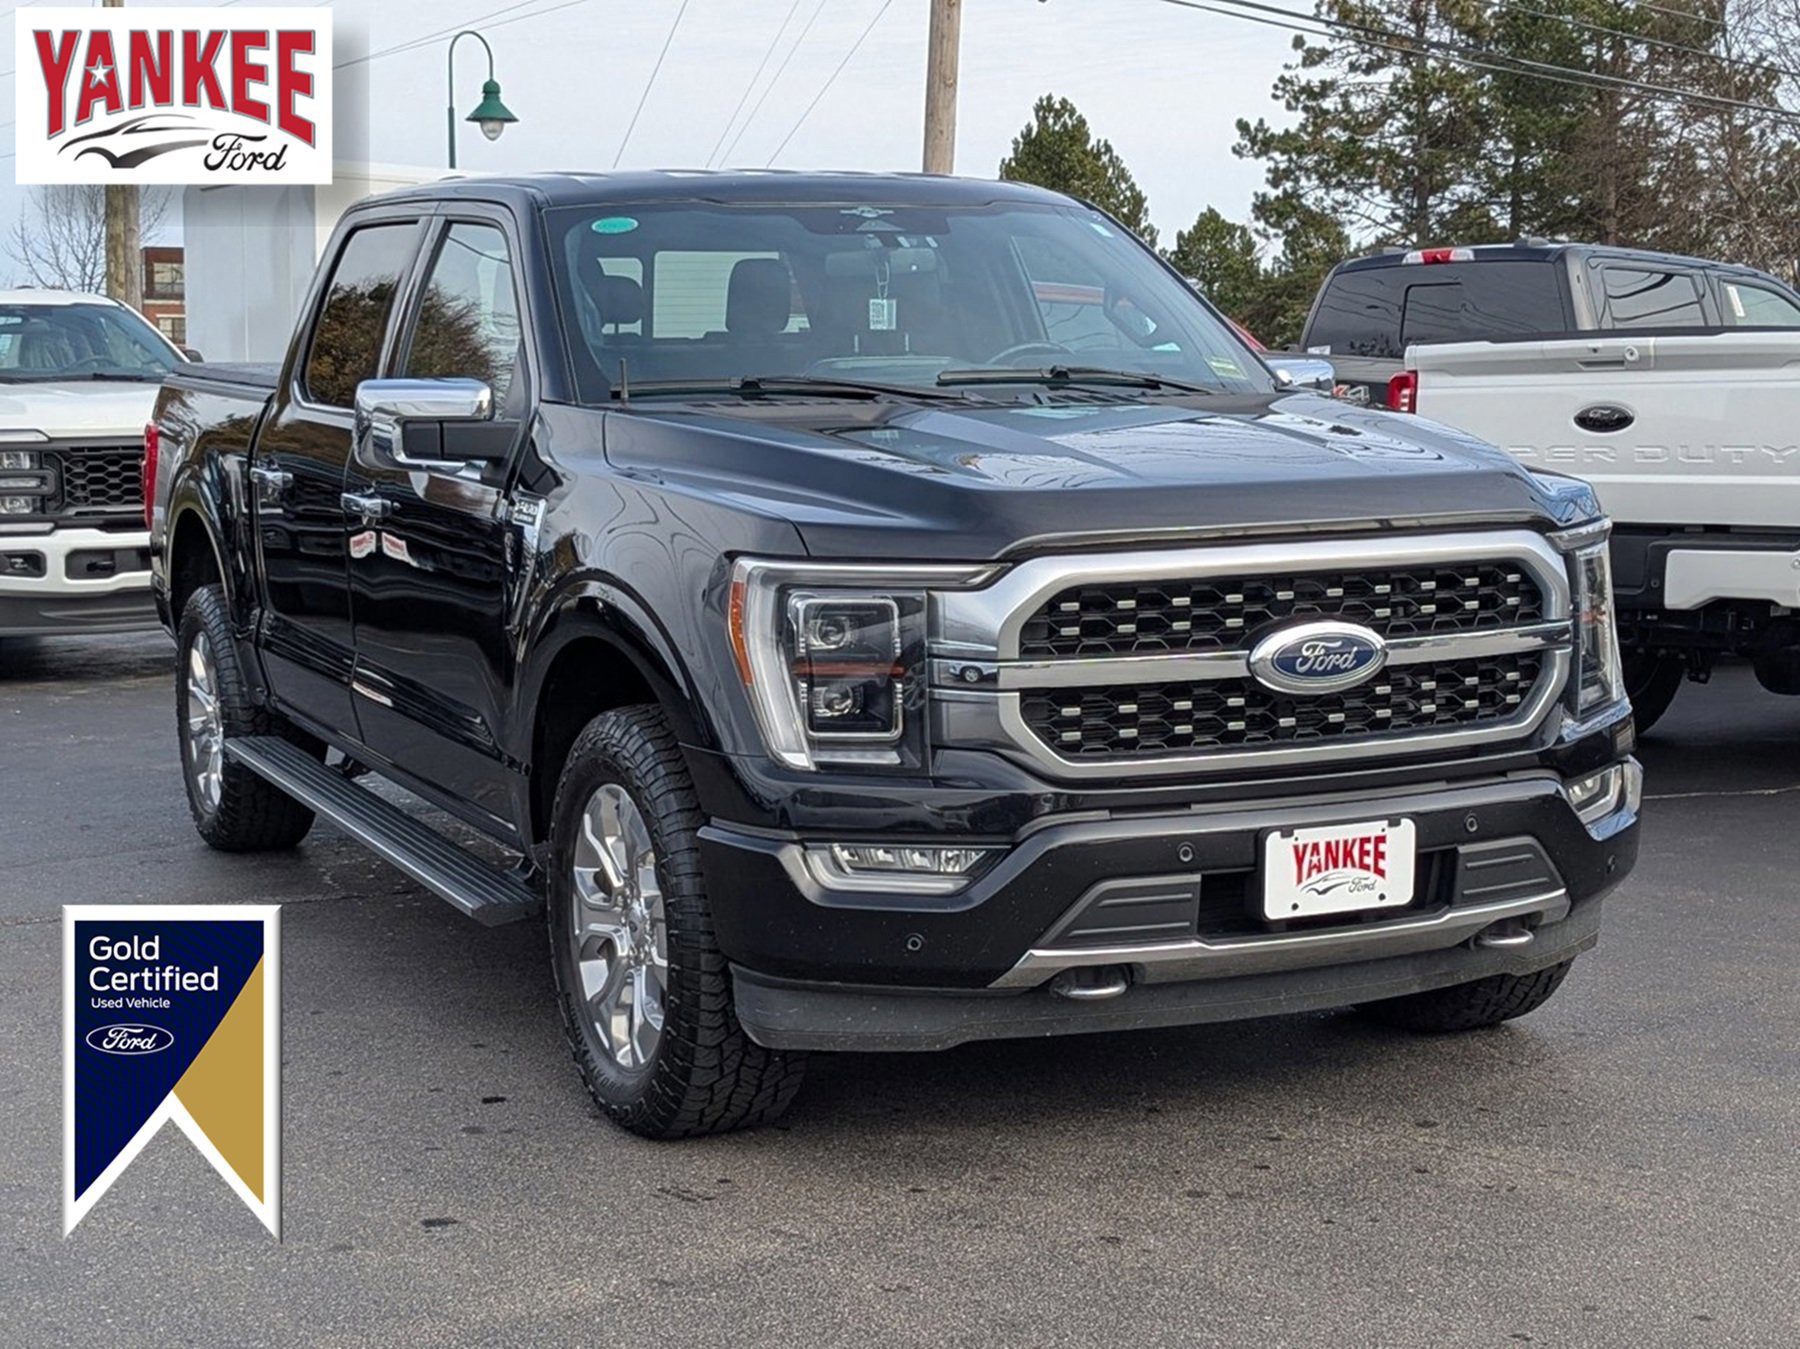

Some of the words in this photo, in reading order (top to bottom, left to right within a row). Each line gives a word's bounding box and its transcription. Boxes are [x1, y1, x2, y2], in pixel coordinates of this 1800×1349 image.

[1507, 444, 1617, 463] PER
[1634, 444, 1799, 464] DUTY
[1295, 640, 1358, 673] Ford
[1292, 834, 1387, 886] YANKEE
[1348, 876, 1377, 894] Ford
